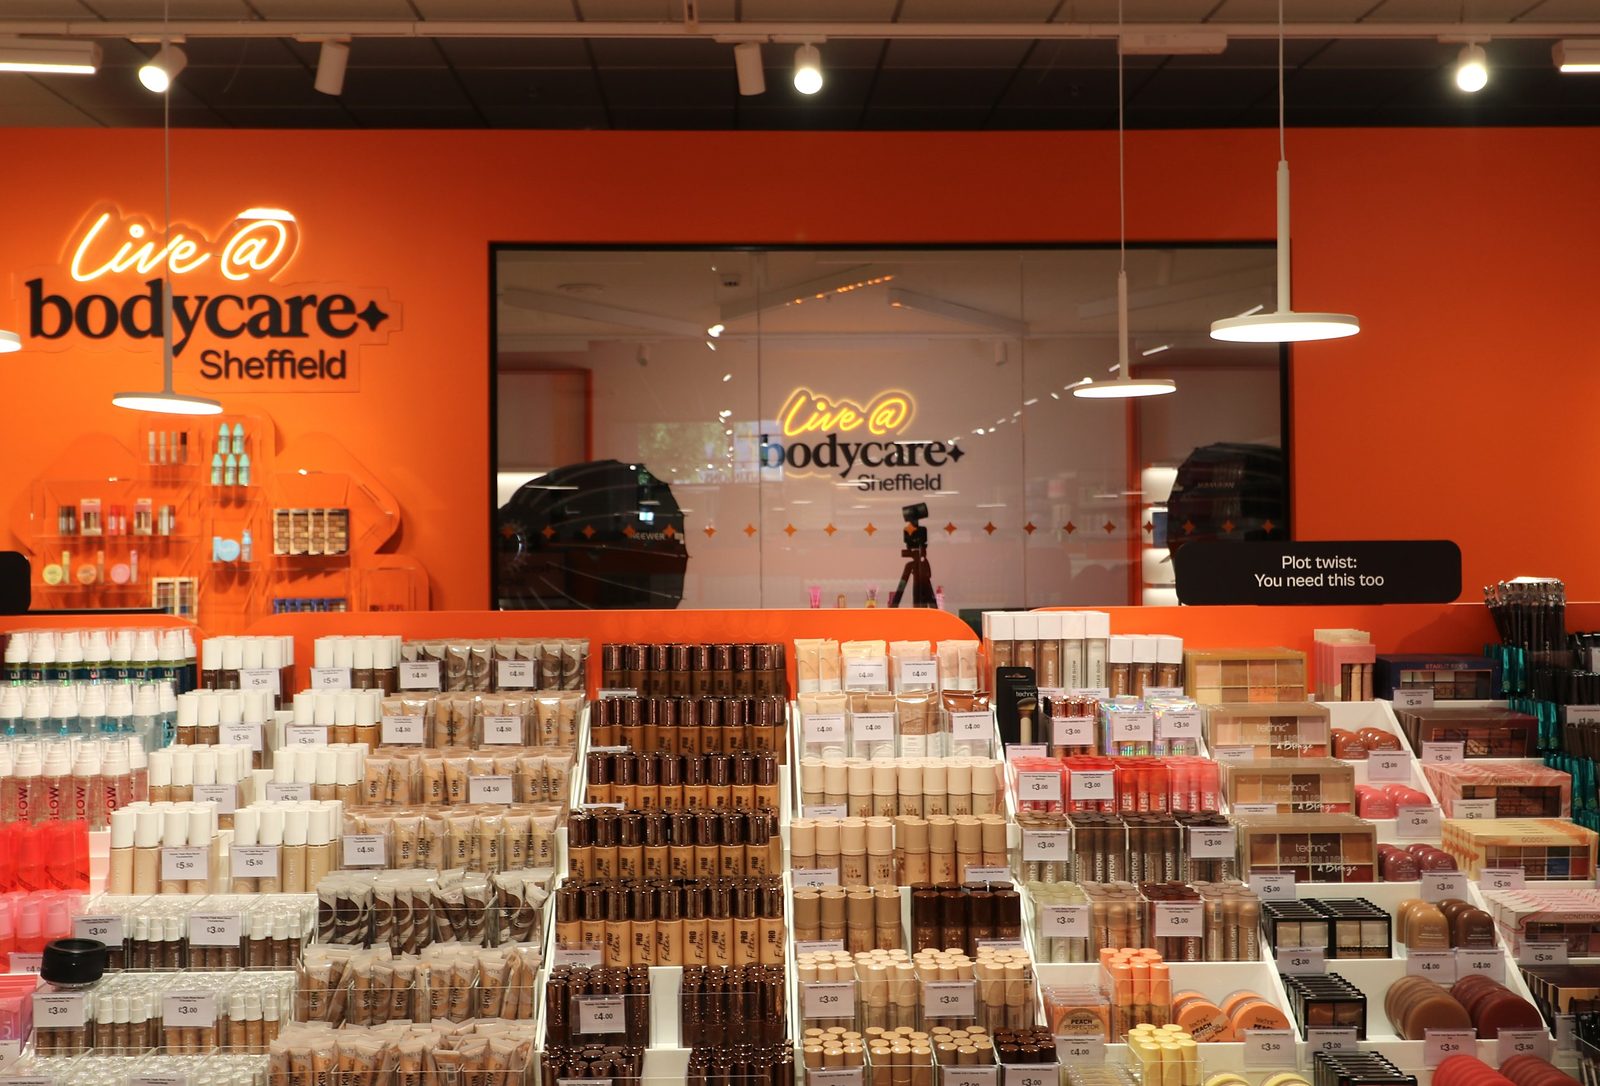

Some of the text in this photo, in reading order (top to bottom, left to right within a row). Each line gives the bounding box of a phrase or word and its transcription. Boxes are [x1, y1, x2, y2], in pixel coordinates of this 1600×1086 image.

[70, 212, 287, 282] Live @
[25, 278, 359, 357] bodycare
[200, 349, 347, 380] Sheffield
[784, 395, 908, 437] Live @
[760, 433, 948, 478] bodycare
[857, 473, 942, 491] Sheffield
[1282, 556, 1357, 569] Plot twist:
[1254, 573, 1384, 588] You need this too
[89, 927, 107, 935] £3.00
[48, 1006, 68, 1014] £3.00
[178, 1006, 198, 1014] £3.00
[1192, 1022, 1212, 1035] PEACH
[1262, 1042, 1280, 1051] £3.50
